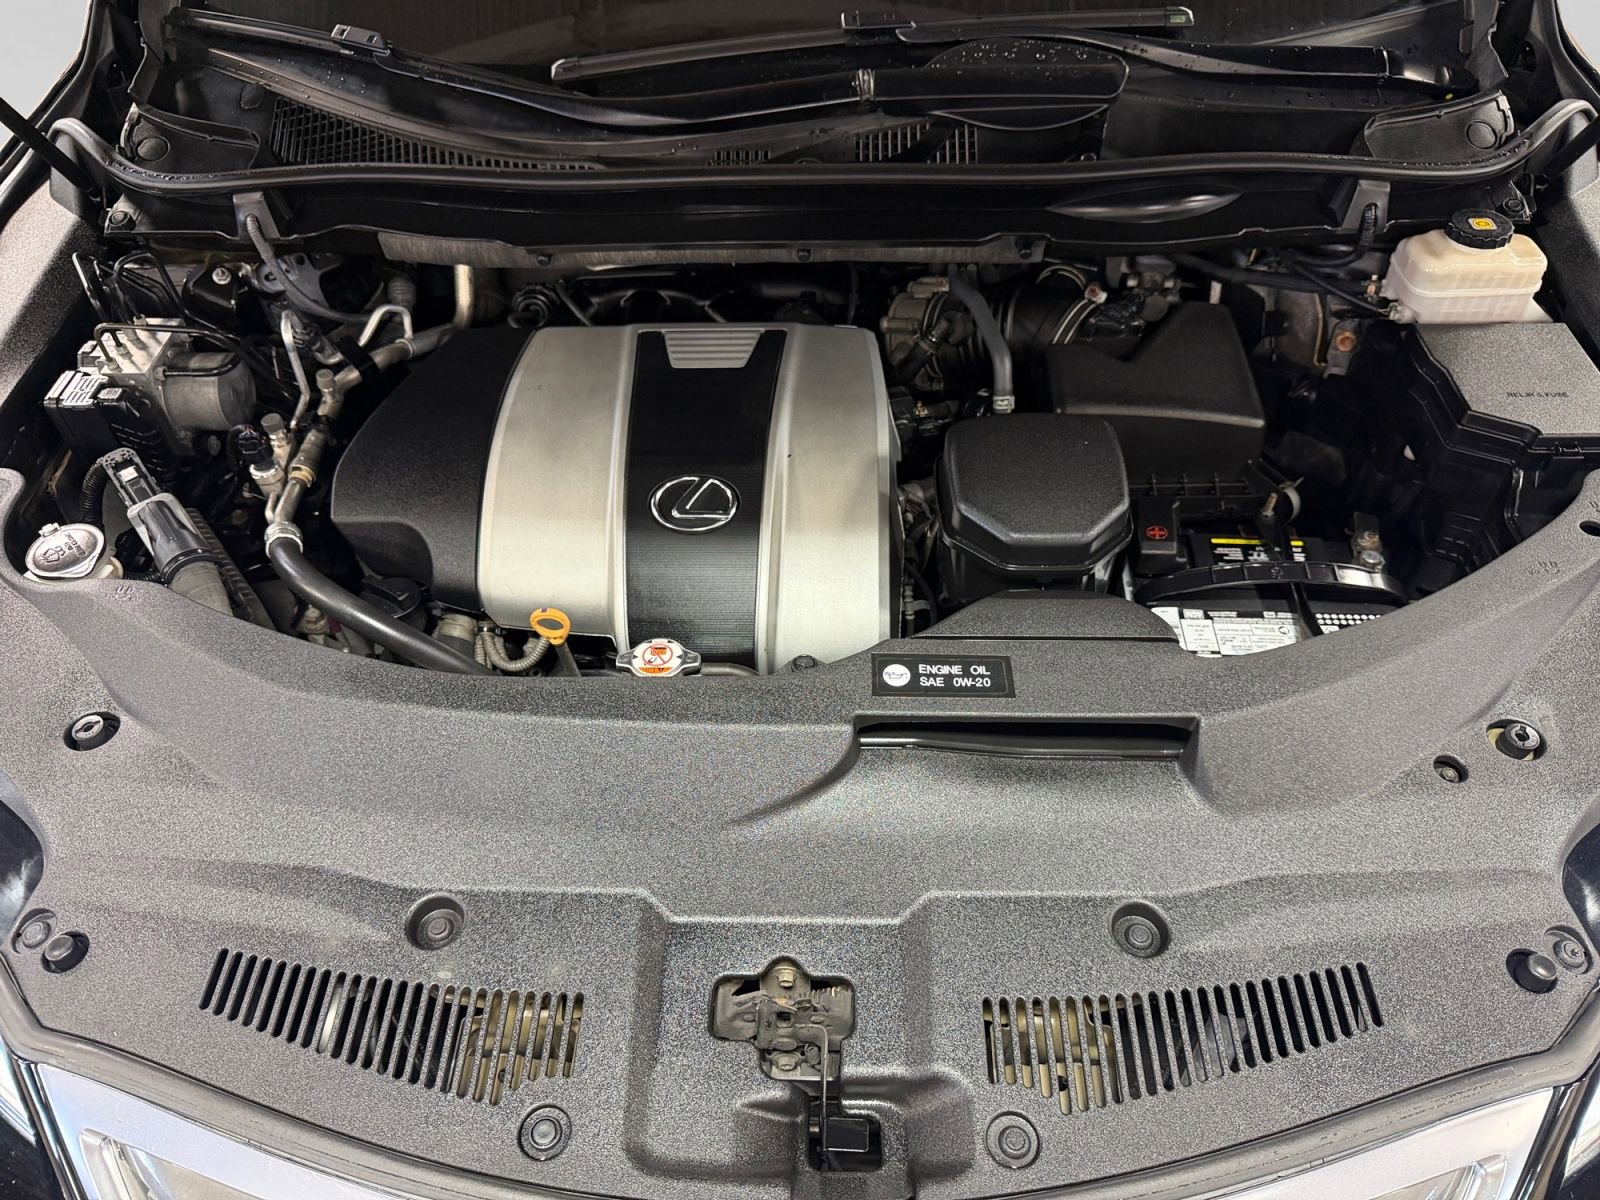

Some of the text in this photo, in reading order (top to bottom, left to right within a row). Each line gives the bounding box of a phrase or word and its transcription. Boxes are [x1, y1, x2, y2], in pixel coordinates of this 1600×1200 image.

[918, 664, 990, 675] ENGINE OIL
[919, 676, 991, 687] SAE 0W-20
